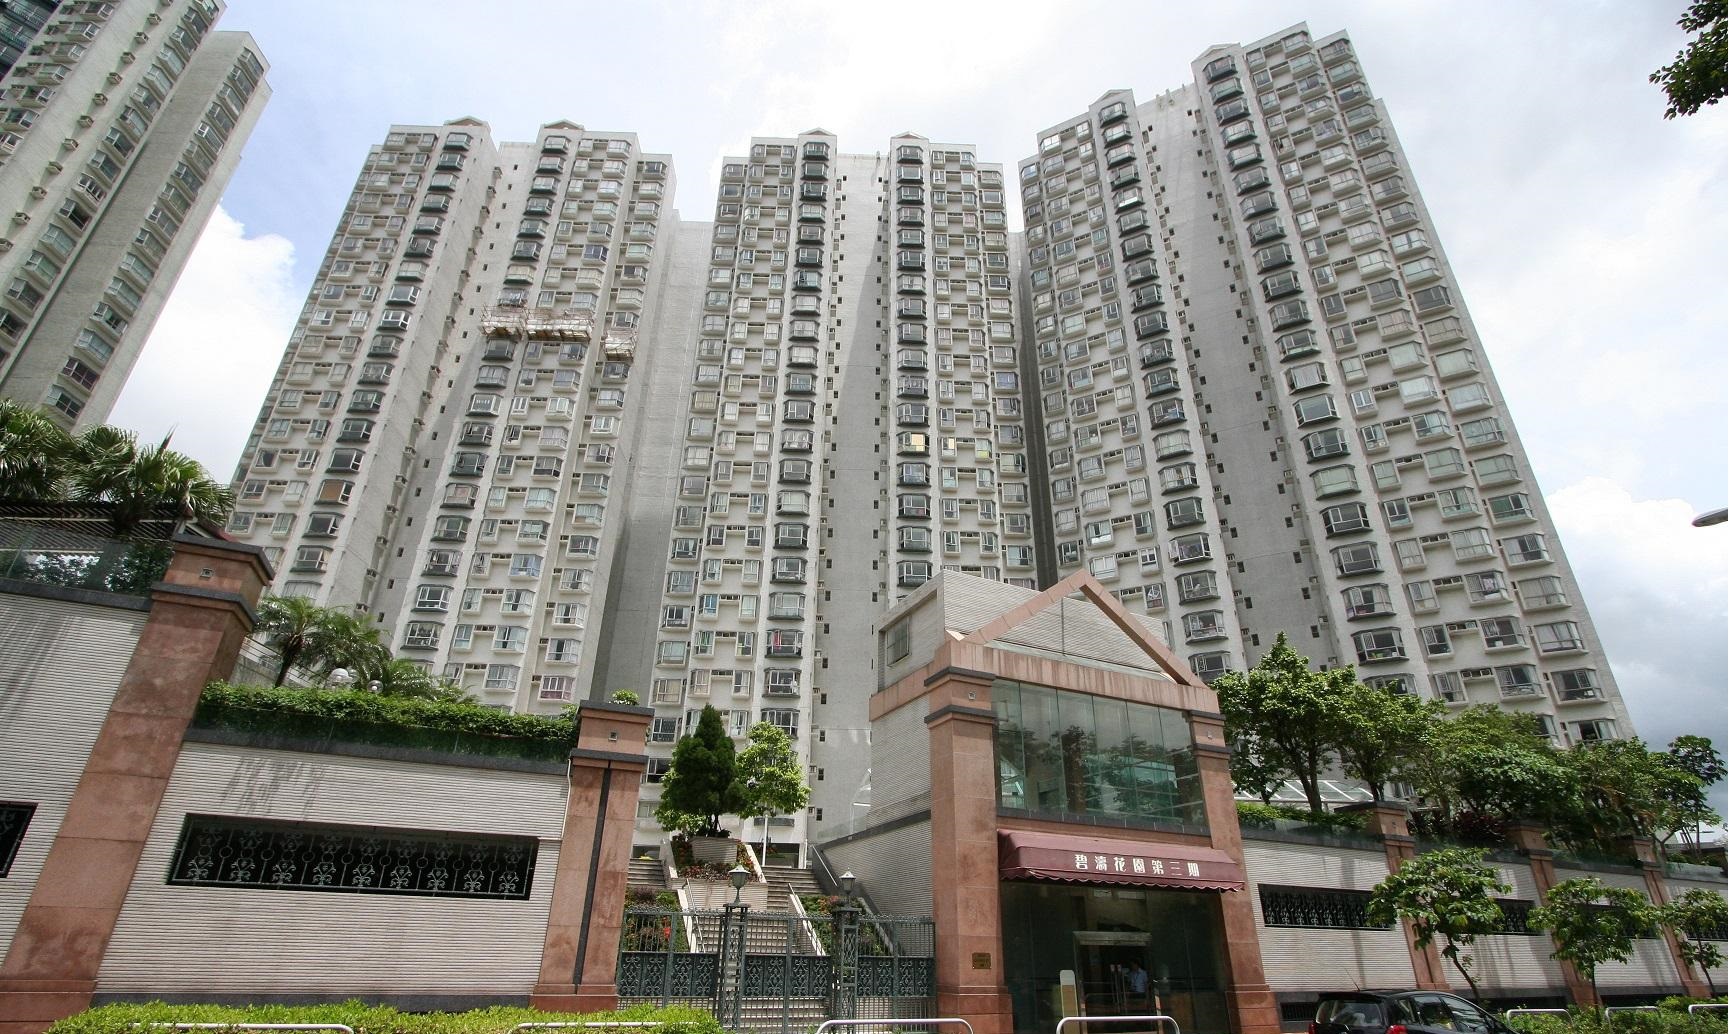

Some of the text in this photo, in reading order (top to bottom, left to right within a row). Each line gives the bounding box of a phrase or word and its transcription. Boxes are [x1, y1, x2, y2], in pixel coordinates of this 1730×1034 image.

[1075, 854, 1200, 877] 碧濤花園第三期
